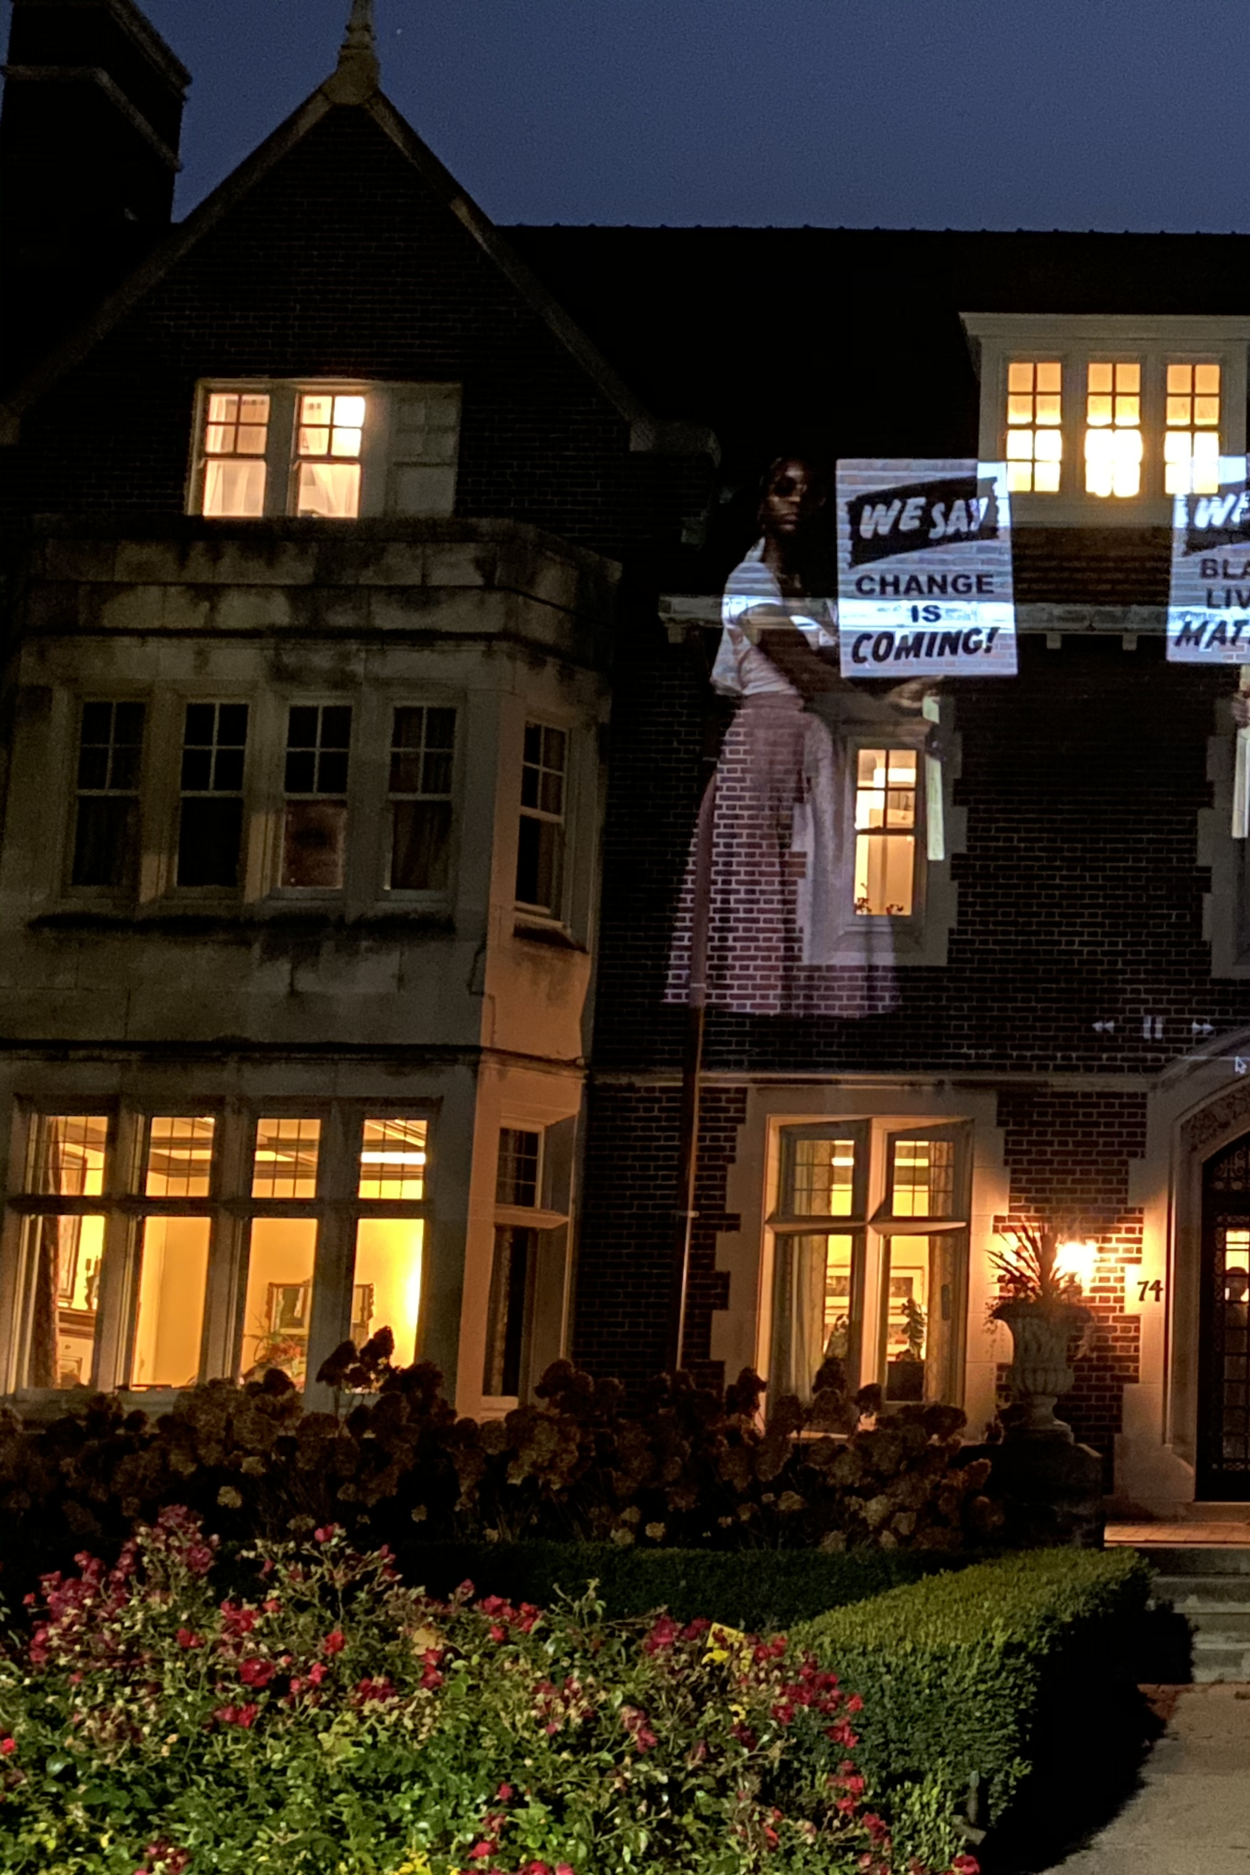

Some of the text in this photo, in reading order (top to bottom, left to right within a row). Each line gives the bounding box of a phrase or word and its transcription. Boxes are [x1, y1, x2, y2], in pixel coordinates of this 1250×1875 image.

[859, 497, 989, 540] WE SAY
[854, 573, 995, 596] CHANGE
[910, 605, 942, 623] IS
[851, 627, 1001, 665] COMING!
[1137, 1279, 1164, 1302] 74
